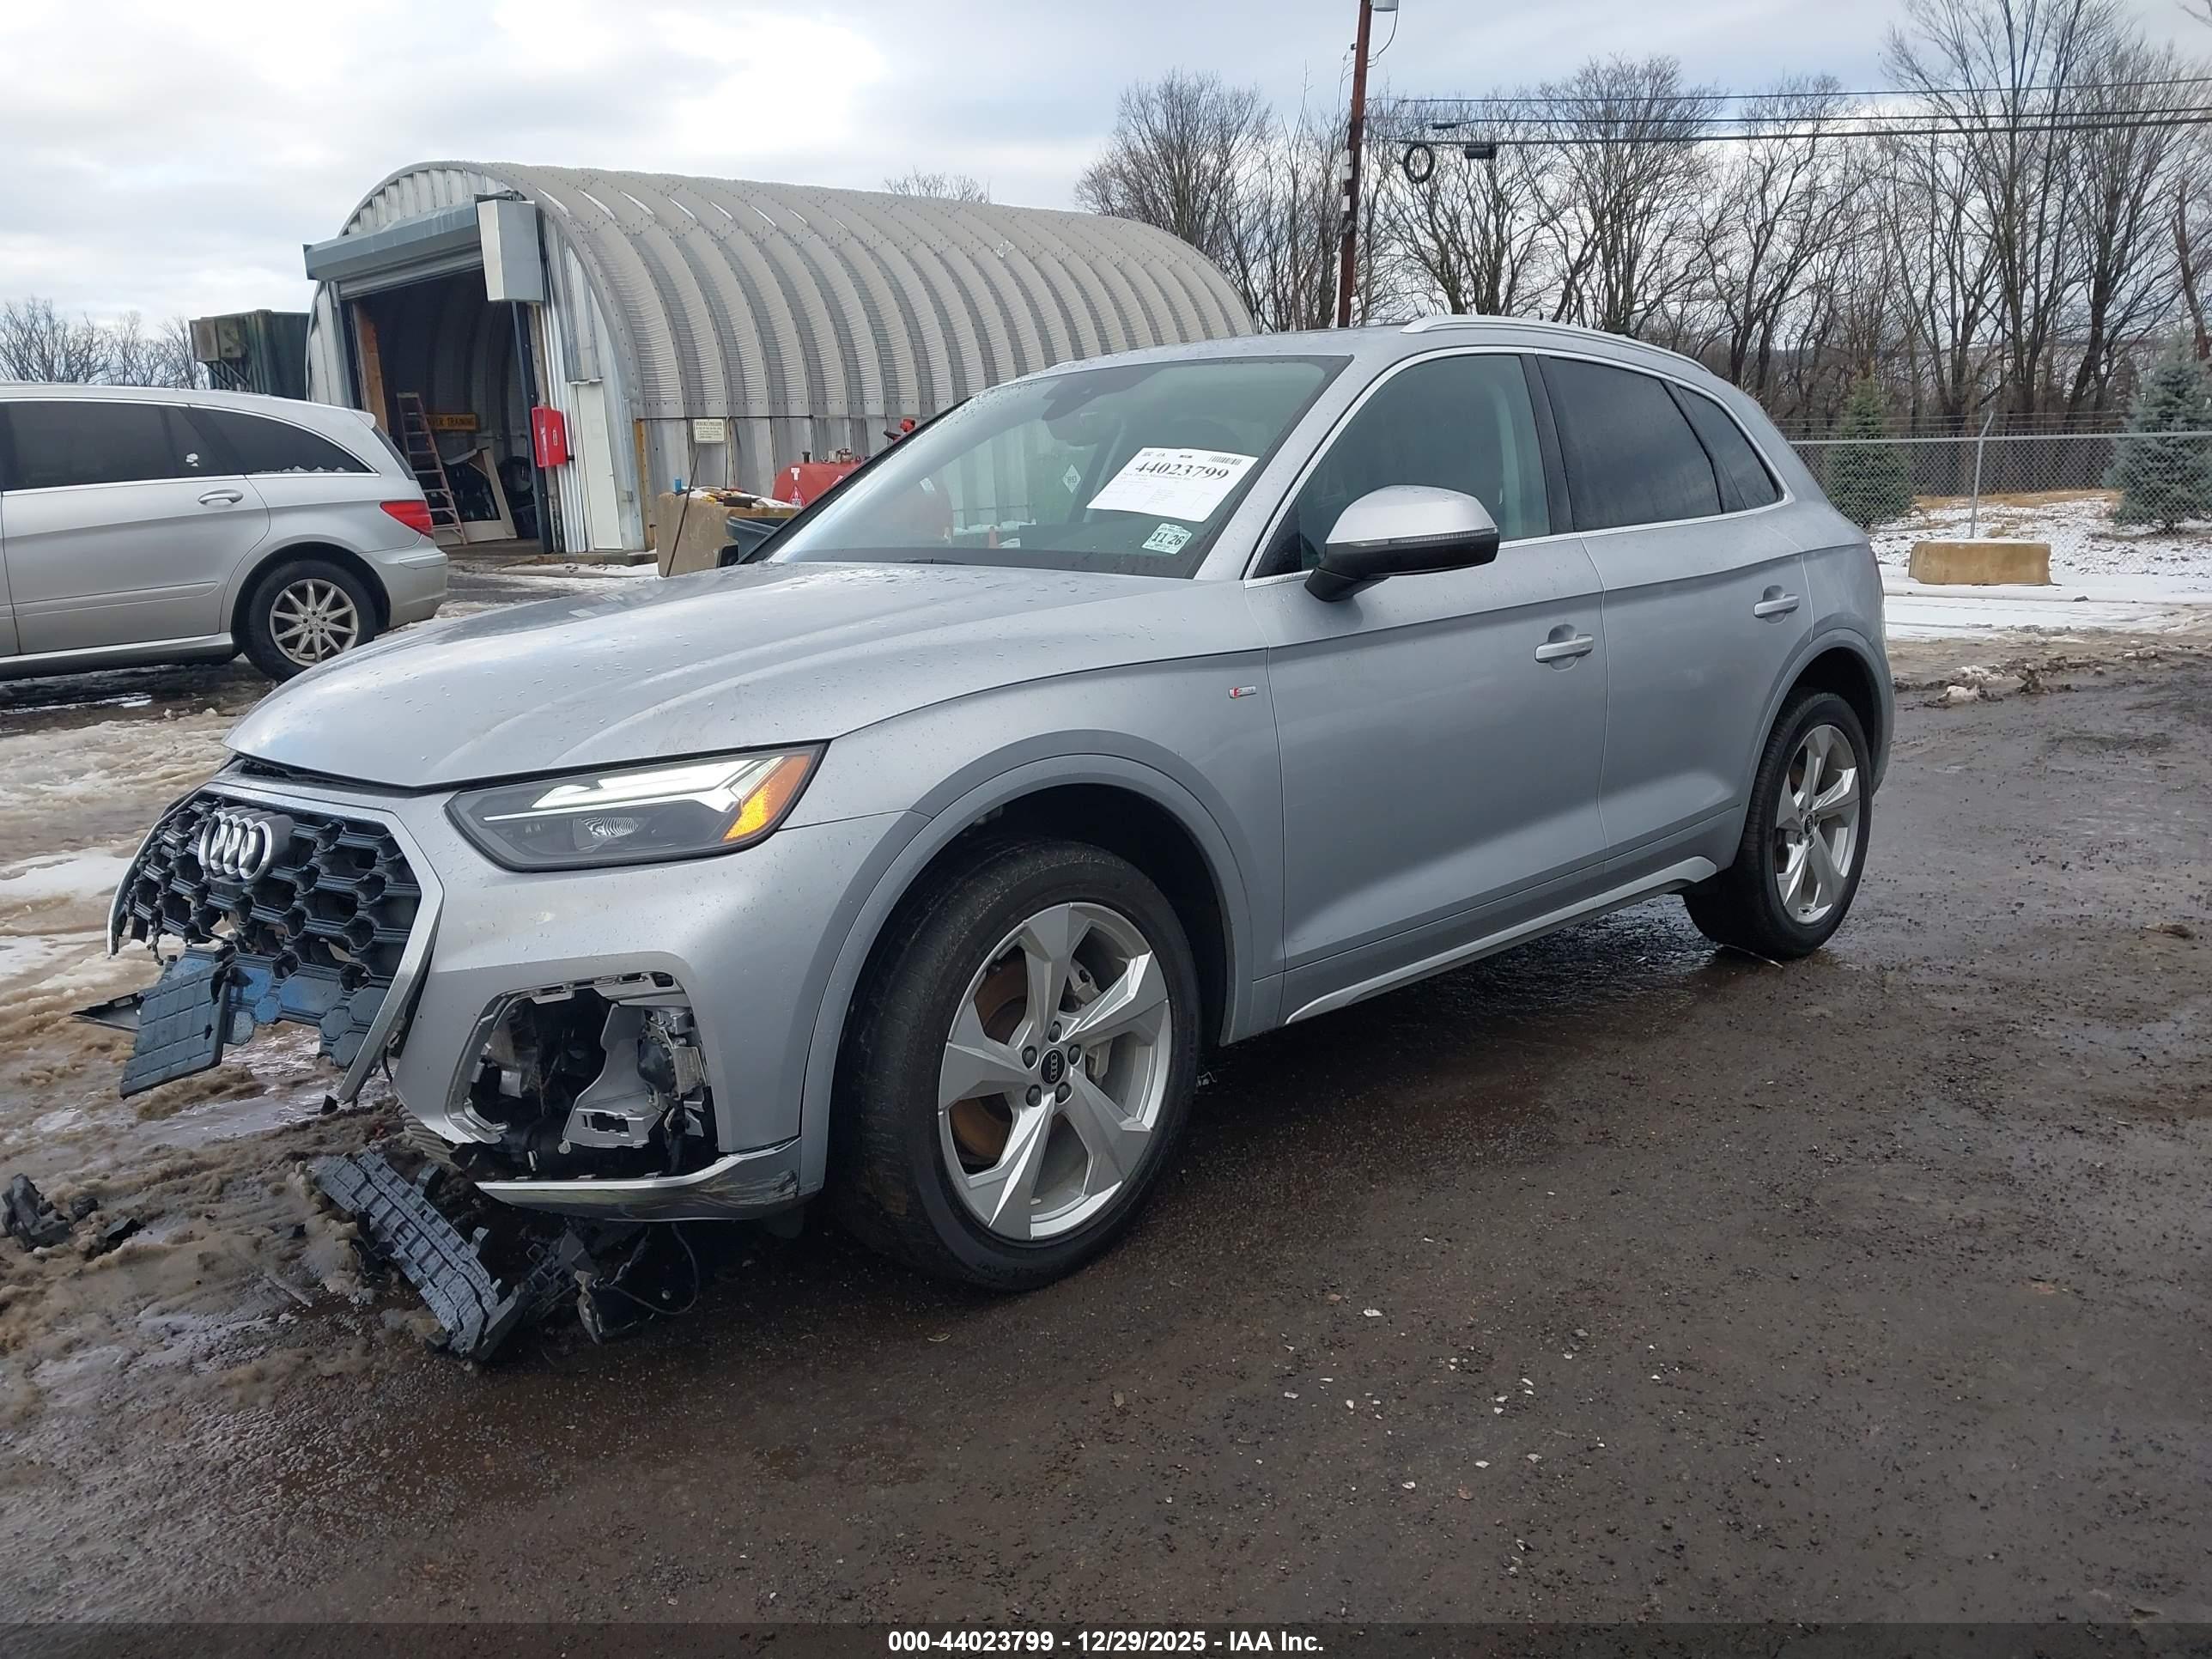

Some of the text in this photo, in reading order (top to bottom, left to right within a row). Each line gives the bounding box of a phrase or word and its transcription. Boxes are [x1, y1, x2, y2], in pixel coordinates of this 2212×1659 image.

[1135, 460, 1229, 480] 44023799
[1152, 532, 1185, 545] 11 26
